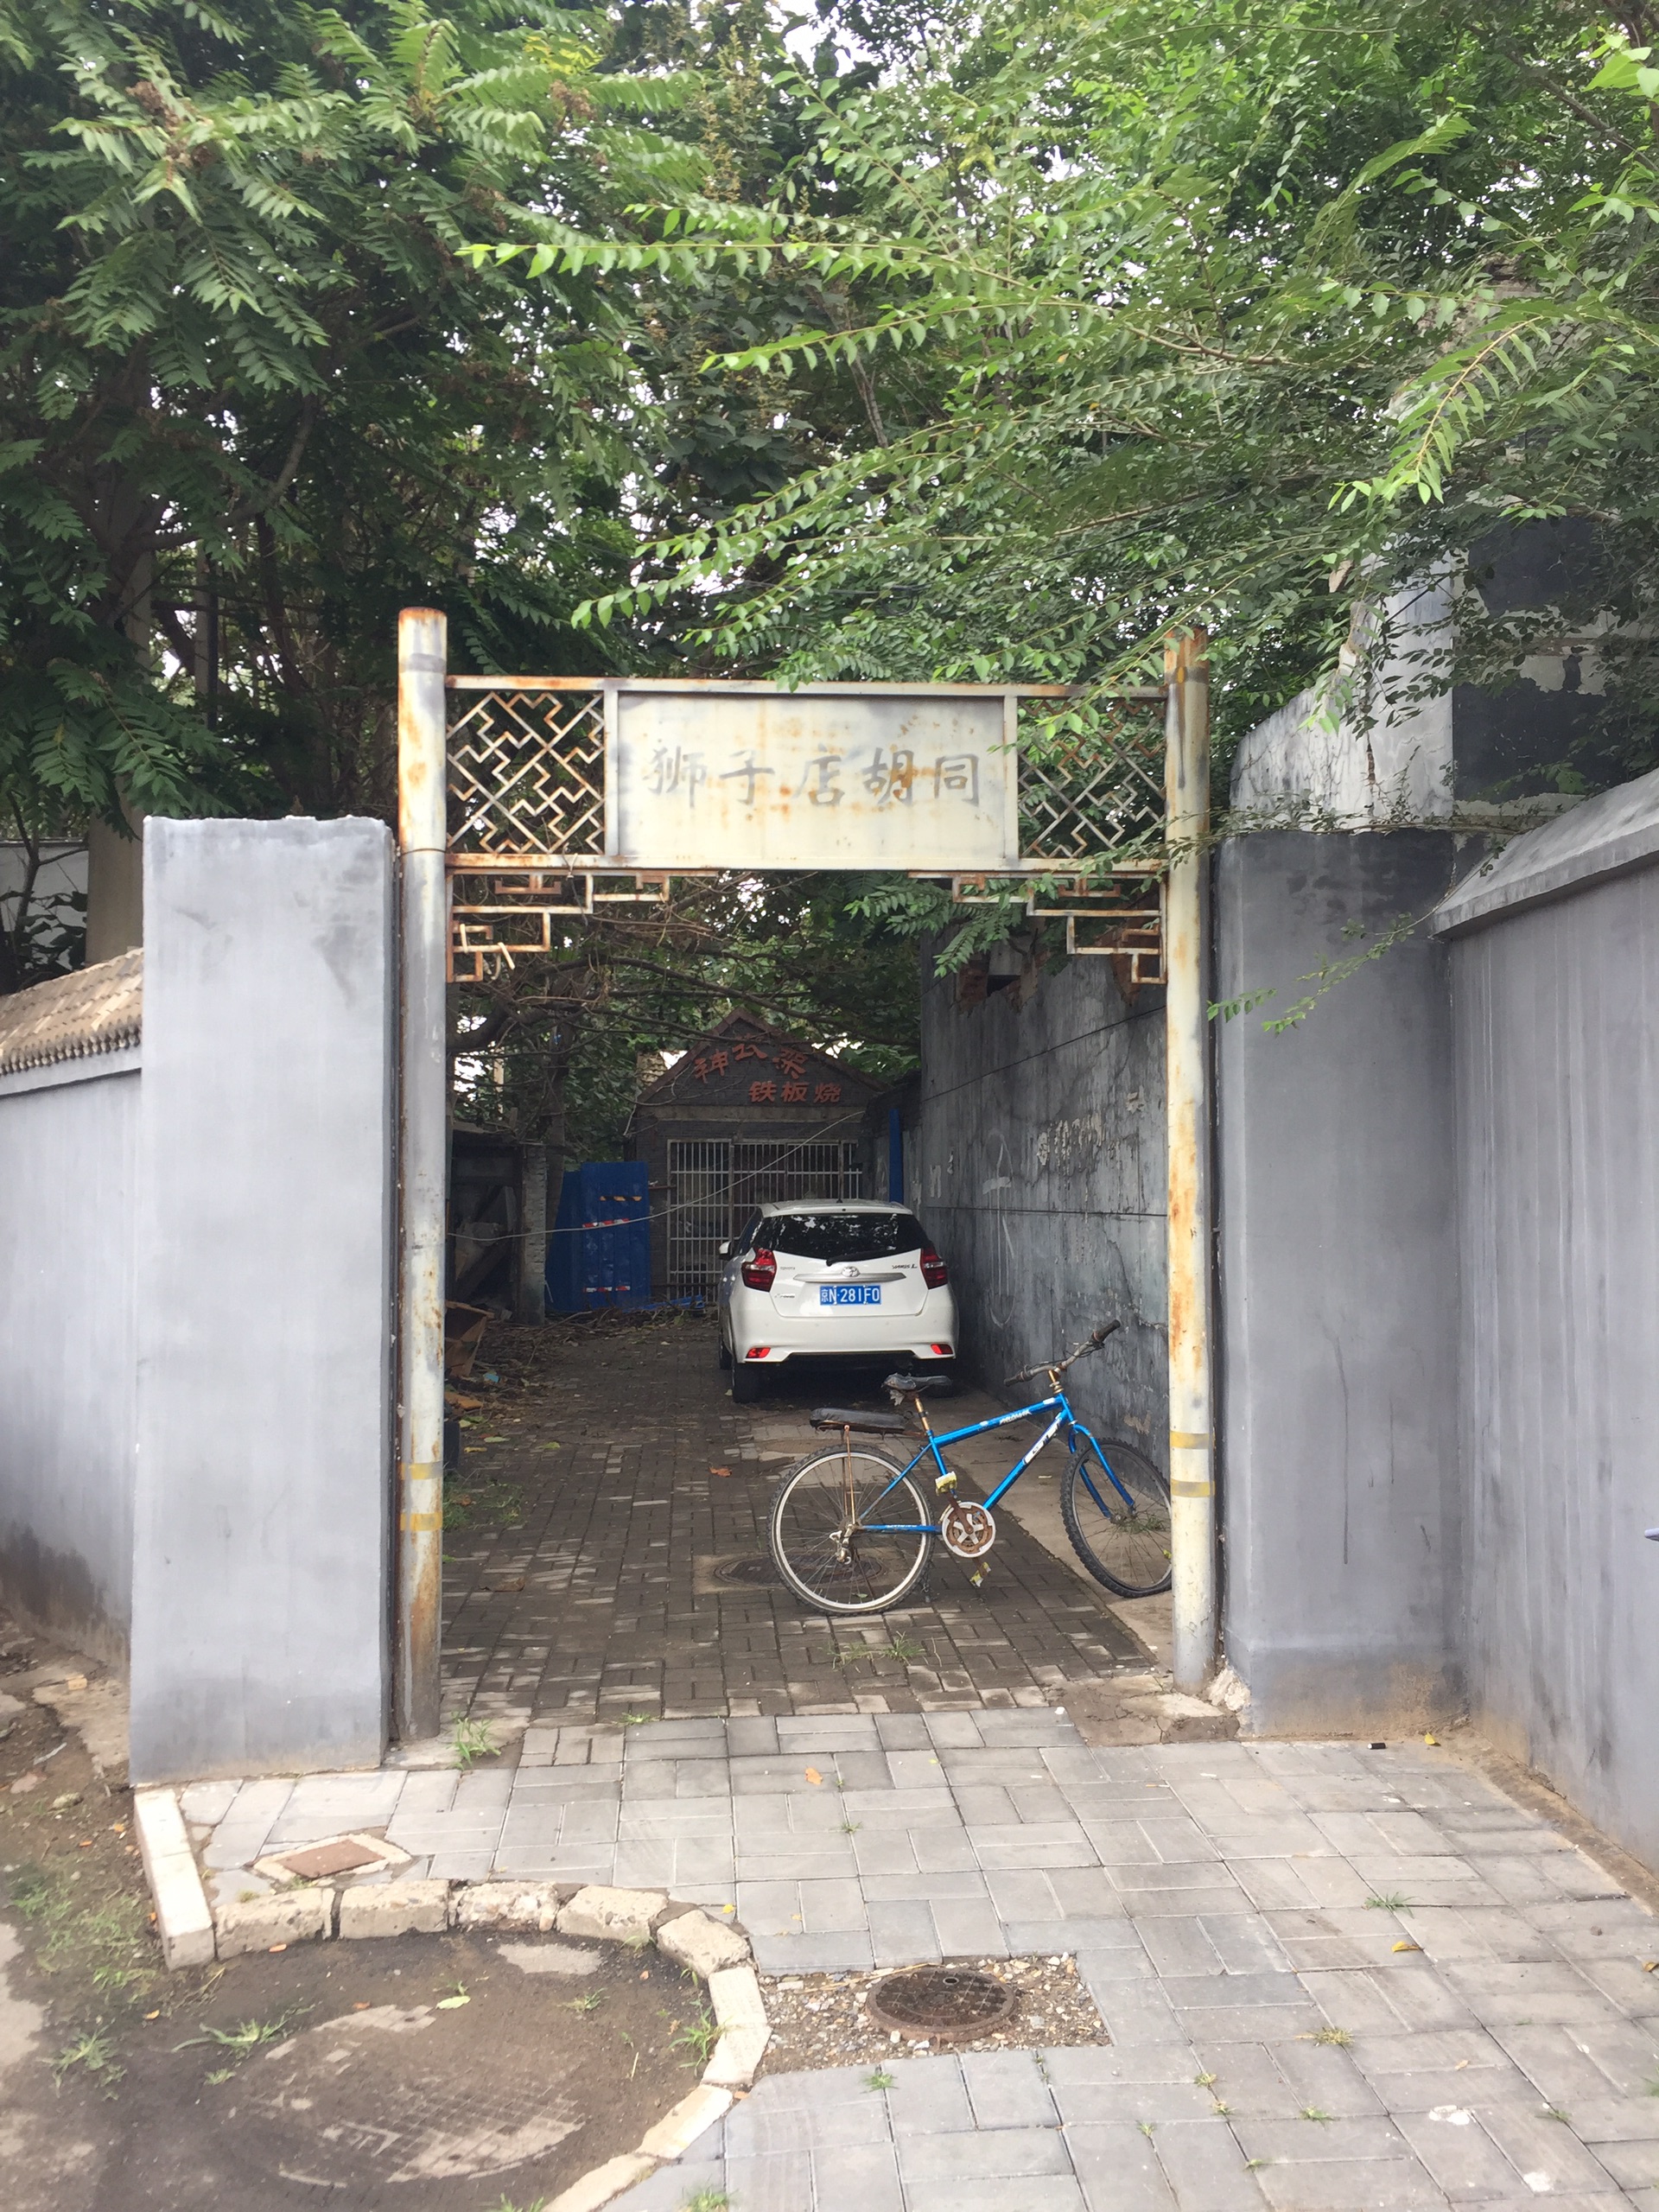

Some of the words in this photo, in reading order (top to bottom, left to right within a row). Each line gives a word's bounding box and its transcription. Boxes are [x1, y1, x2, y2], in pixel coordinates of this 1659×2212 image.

[643, 746, 980, 808] 狮子店胡同
[748, 1080, 842, 1103] 铁板烧
